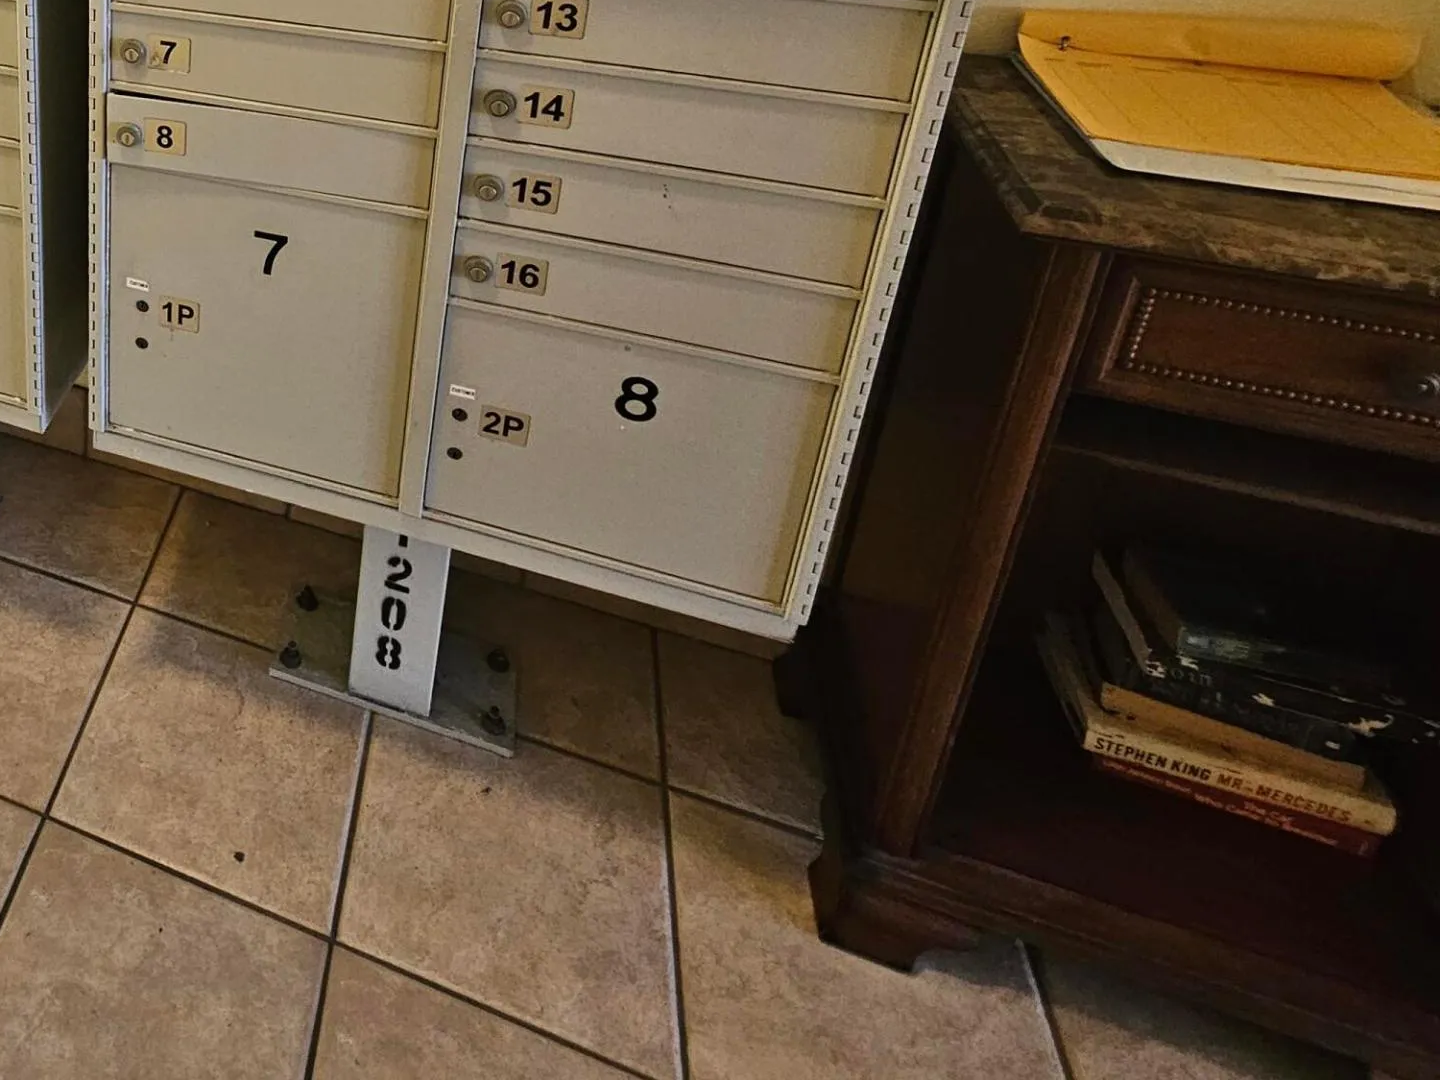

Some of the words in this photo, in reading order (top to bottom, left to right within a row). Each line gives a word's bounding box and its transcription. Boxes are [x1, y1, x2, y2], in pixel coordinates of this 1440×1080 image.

[537, 2, 577, 31] 13
[160, 41, 176, 64] 7
[525, 92, 564, 121] 14
[157, 126, 173, 148] 8
[513, 178, 552, 206] 15
[254, 231, 288, 275] 7
[502, 261, 539, 288] 16
[163, 302, 194, 324] 1P
[615, 377, 658, 421] 8
[483, 412, 524, 436] 2P
[375, 534, 413, 670] 208
[1094, 738, 1167, 769] STEPHEN
[1170, 758, 1212, 782] KING
[1255, 784, 1352, 822] MERCEDES
